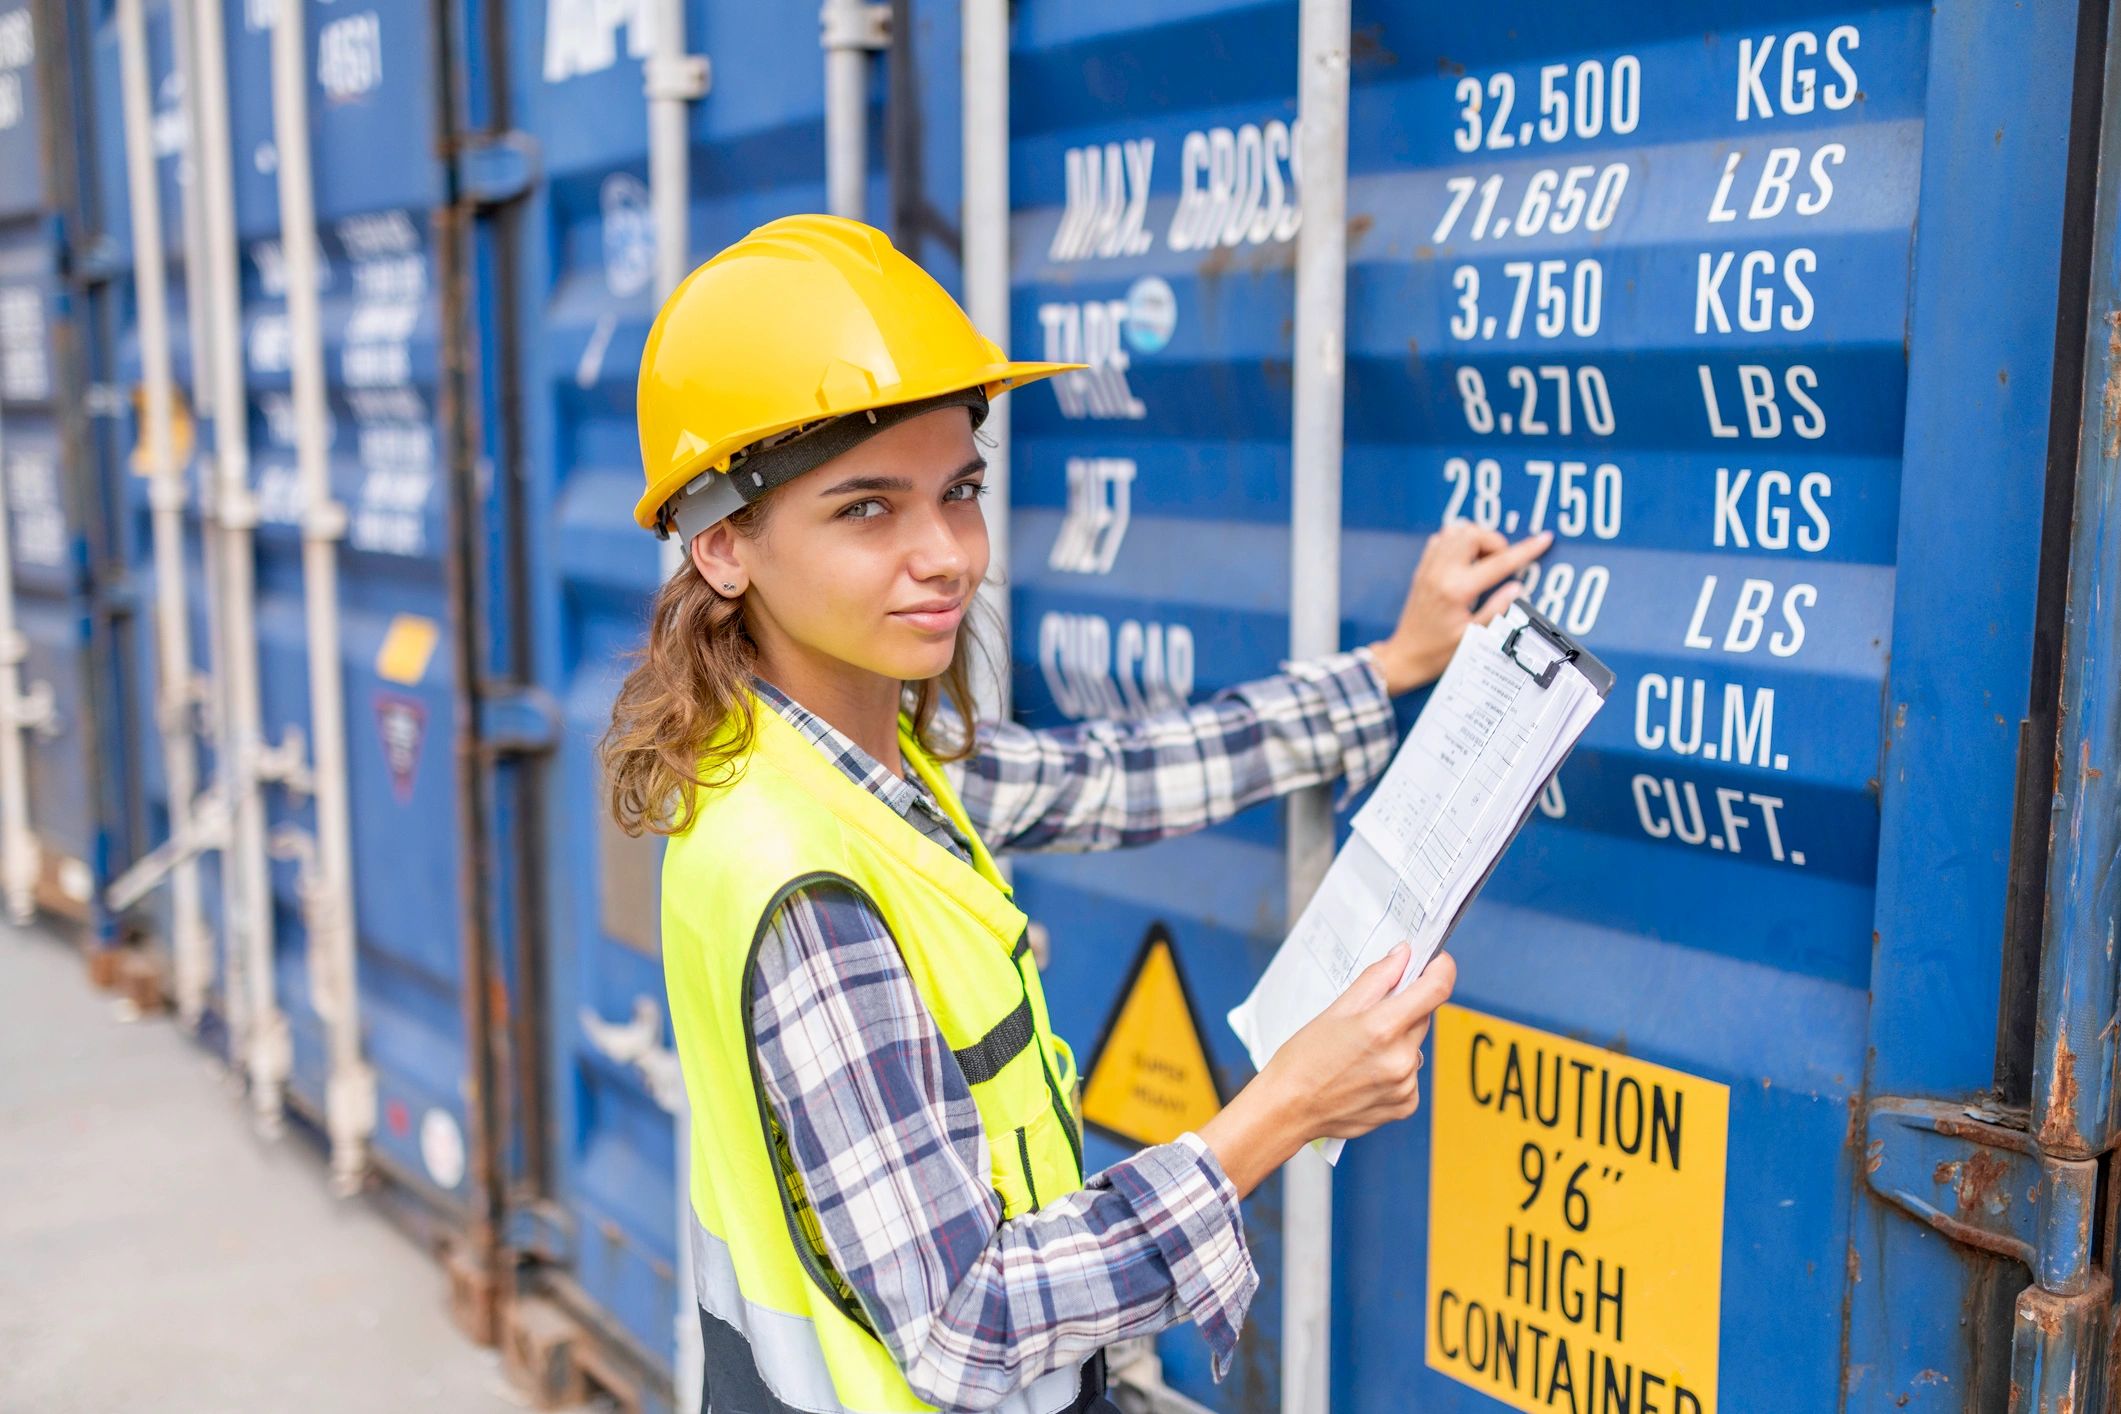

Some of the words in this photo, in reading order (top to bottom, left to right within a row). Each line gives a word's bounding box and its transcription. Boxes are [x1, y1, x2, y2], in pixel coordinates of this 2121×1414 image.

[1454, 55, 1641, 153] 32,500
[1735, 25, 1860, 121] KGS
[1432, 162, 1630, 244] 71,650
[1707, 143, 1846, 224] LBS
[1450, 258, 1603, 341] 3,750
[1694, 248, 1818, 335] KGS
[1456, 365, 1616, 436] 8,270
[1698, 364, 1827, 440] LBS
[1443, 457, 1623, 540] 28,750
[1713, 467, 1832, 553] KGS
[1683, 574, 1818, 658] LBS
[1634, 672, 1790, 771] CU.M.
[1631, 773, 1806, 866] CU.FT.
[1470, 1032, 1684, 1172] CAUTION
[1506, 1224, 1626, 1343] HIGH
